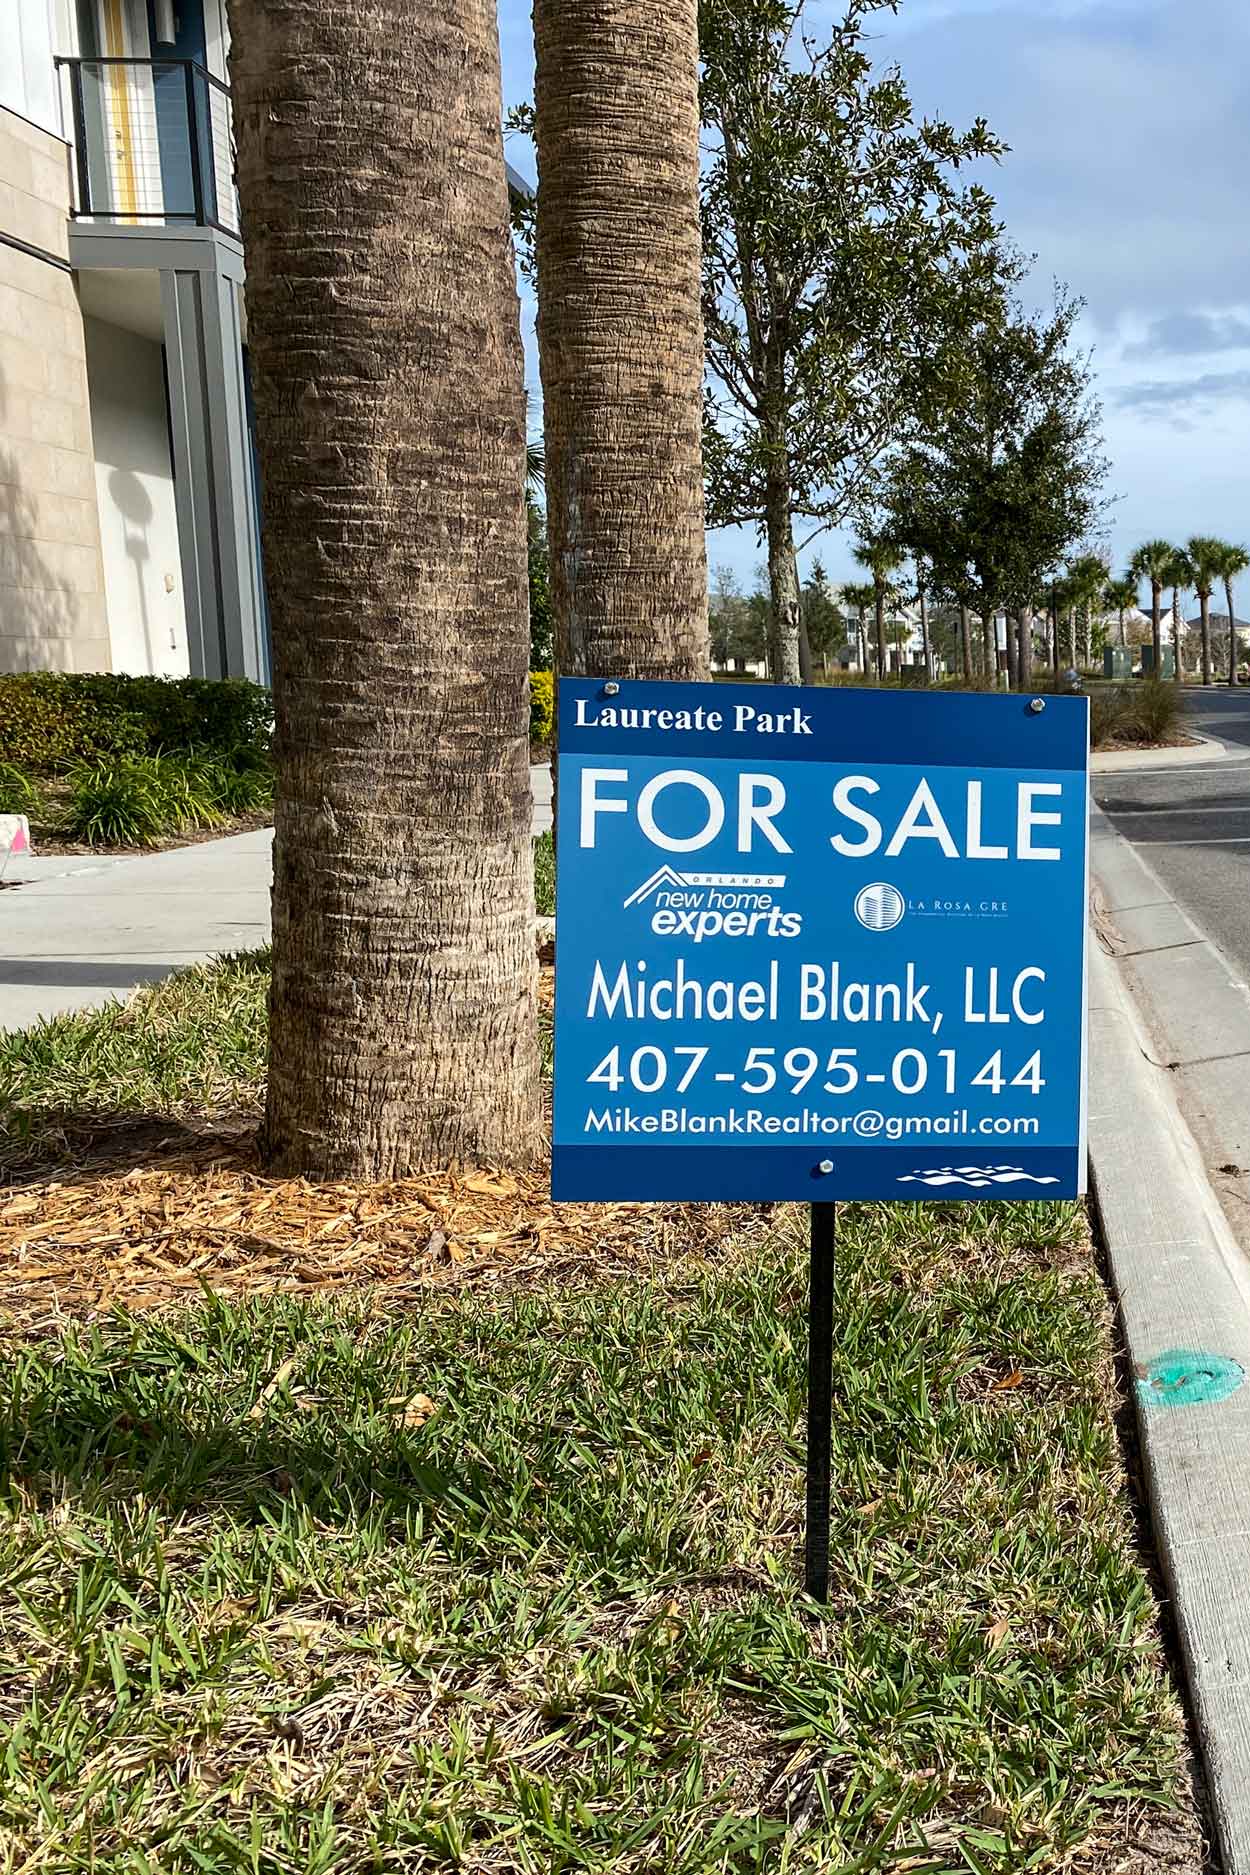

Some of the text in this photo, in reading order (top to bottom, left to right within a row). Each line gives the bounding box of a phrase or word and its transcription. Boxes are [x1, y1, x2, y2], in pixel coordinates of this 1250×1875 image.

[574, 700, 813, 734] Laureate Park
[580, 768, 1062, 860] FOR SALE
[693, 876, 775, 885] ORLANDO
[656, 889, 772, 910] new home
[651, 906, 802, 943] experts
[587, 959, 1045, 1034] Michael Blank, LLC
[586, 1045, 1046, 1095] 407-595-0144
[584, 1108, 1039, 1139] MikeBlankRealtor@gmail.com
